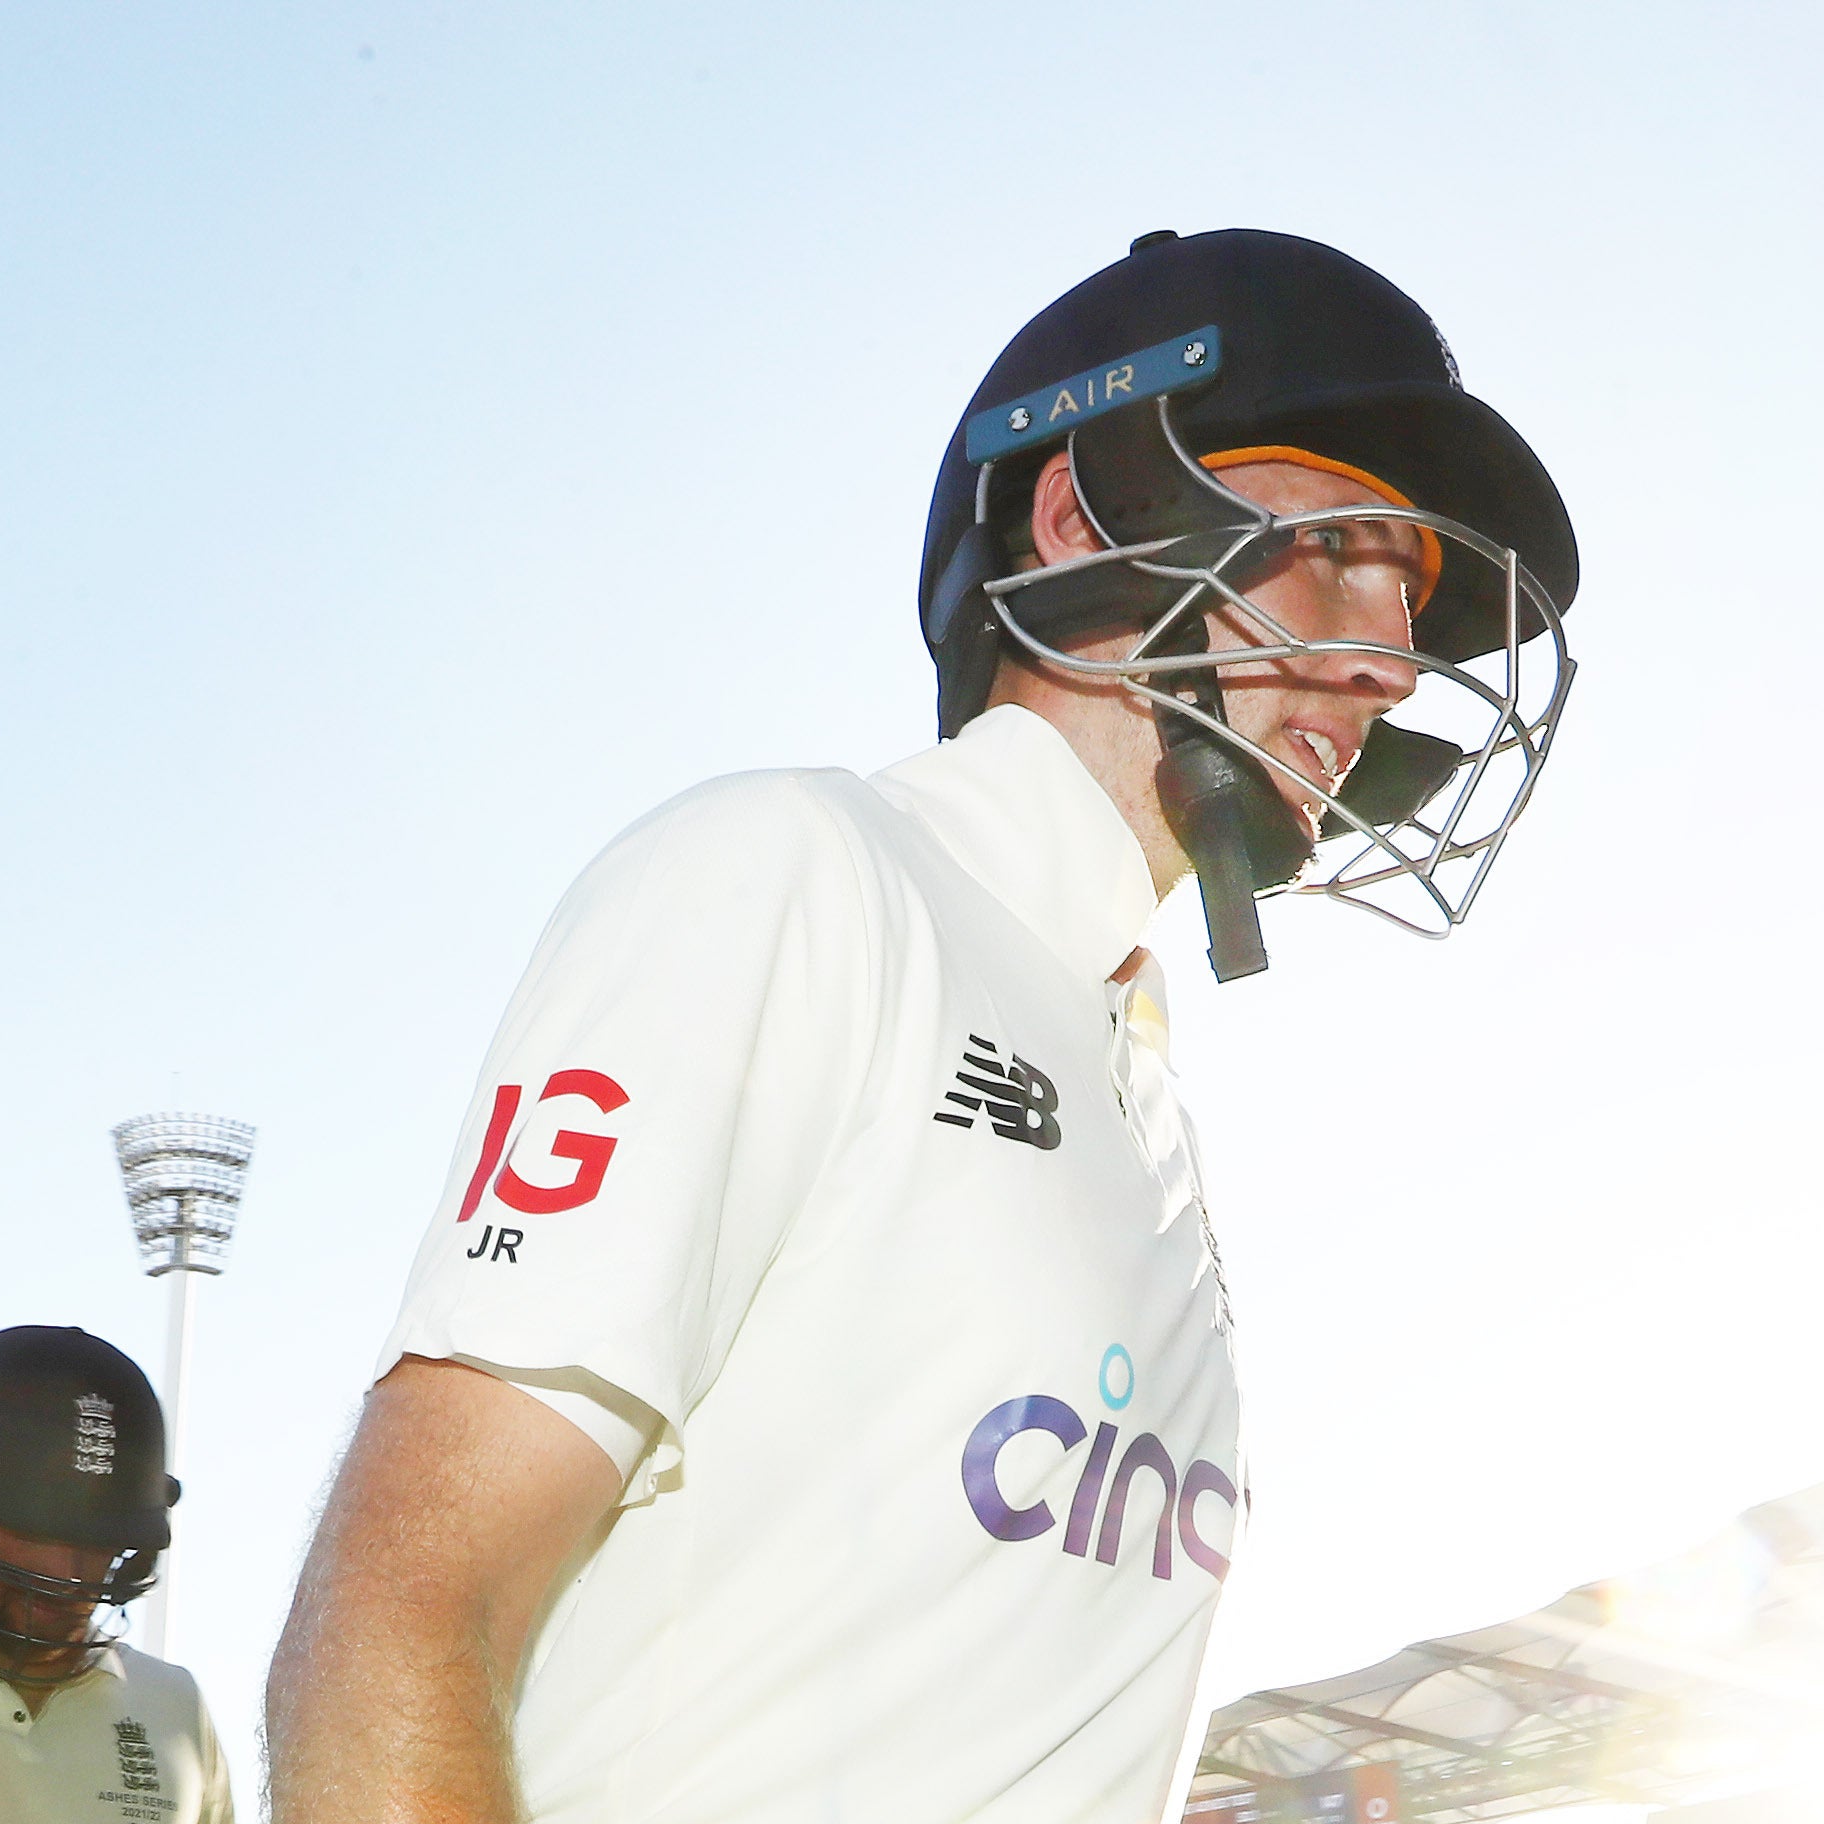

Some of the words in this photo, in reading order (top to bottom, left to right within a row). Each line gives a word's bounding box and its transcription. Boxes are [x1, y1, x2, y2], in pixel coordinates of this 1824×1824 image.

[1047, 363, 1136, 423] AIR
[455, 1067, 633, 1224] IG
[465, 1223, 525, 1265] JR
[960, 1341, 1240, 1583] cinc
[98, 1791, 139, 1806] ASHES
